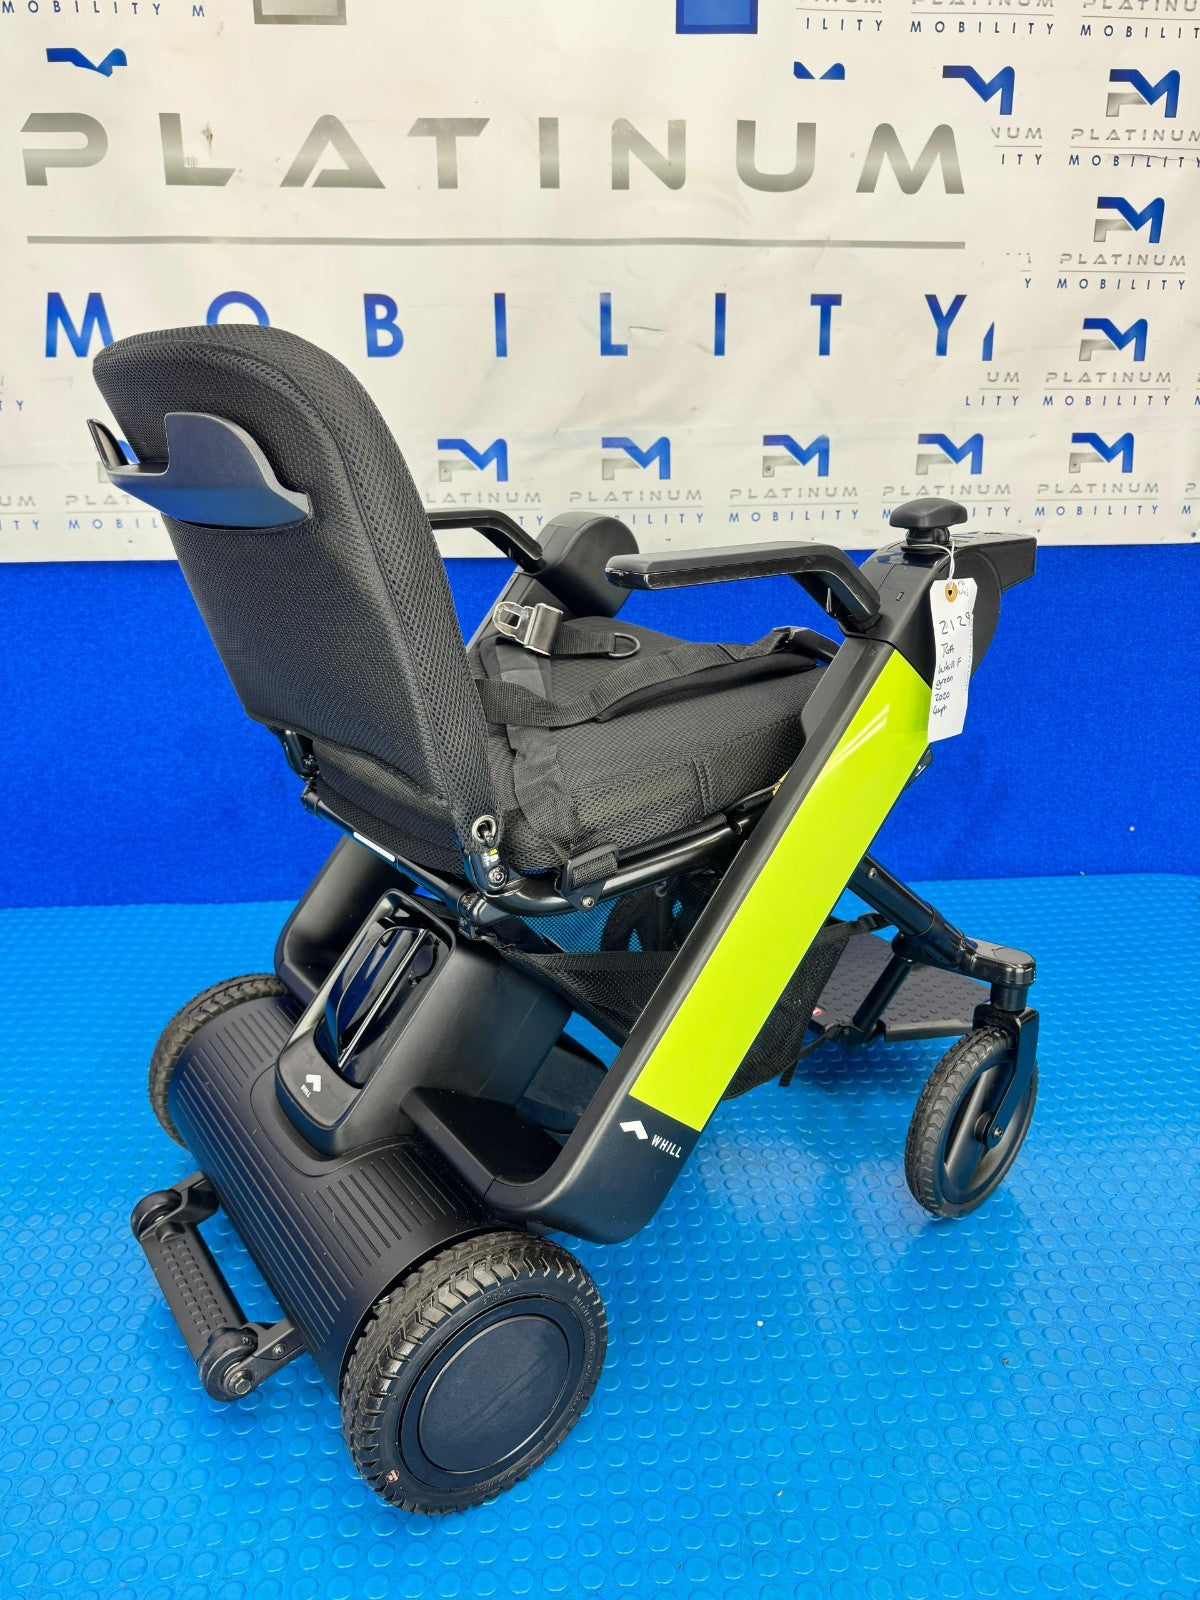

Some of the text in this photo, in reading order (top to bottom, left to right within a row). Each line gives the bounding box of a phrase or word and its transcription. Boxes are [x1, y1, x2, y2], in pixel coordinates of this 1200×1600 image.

[2, 1, 160, 15] MOBILITY
[1083, 0, 1197, 11] PLATINU
[910, 20, 1054, 35] MOBILITY
[1080, 24, 1200, 38] MOBILIT
[1071, 128, 1200, 141] PLATINUM
[20, 112, 965, 195] PLATINUM
[1059, 253, 1186, 266] PLATINUM
[1056, 278, 1185, 290] MOBILITY
[45, 290, 967, 358] MOBILITY
[1045, 371, 1172, 383] PLATINUM
[1042, 395, 1171, 406] MOBILITY
[729, 486, 858, 499] PLATINUM
[882, 484, 1011, 496] PLATINUM
[1037, 482, 1159, 494] PLATINUM
[65, 494, 131, 506] PLAT
[426, 492, 541, 503] LATINUM
[569, 489, 702, 502] PLATINUM
[729, 509, 858, 522] MOBILITY
[1034, 505, 1158, 516] MOBILITY
[69, 518, 159, 530] MOBIL
[615, 513, 703, 525] ILITY
[651, 1134, 682, 1159] WHILL
